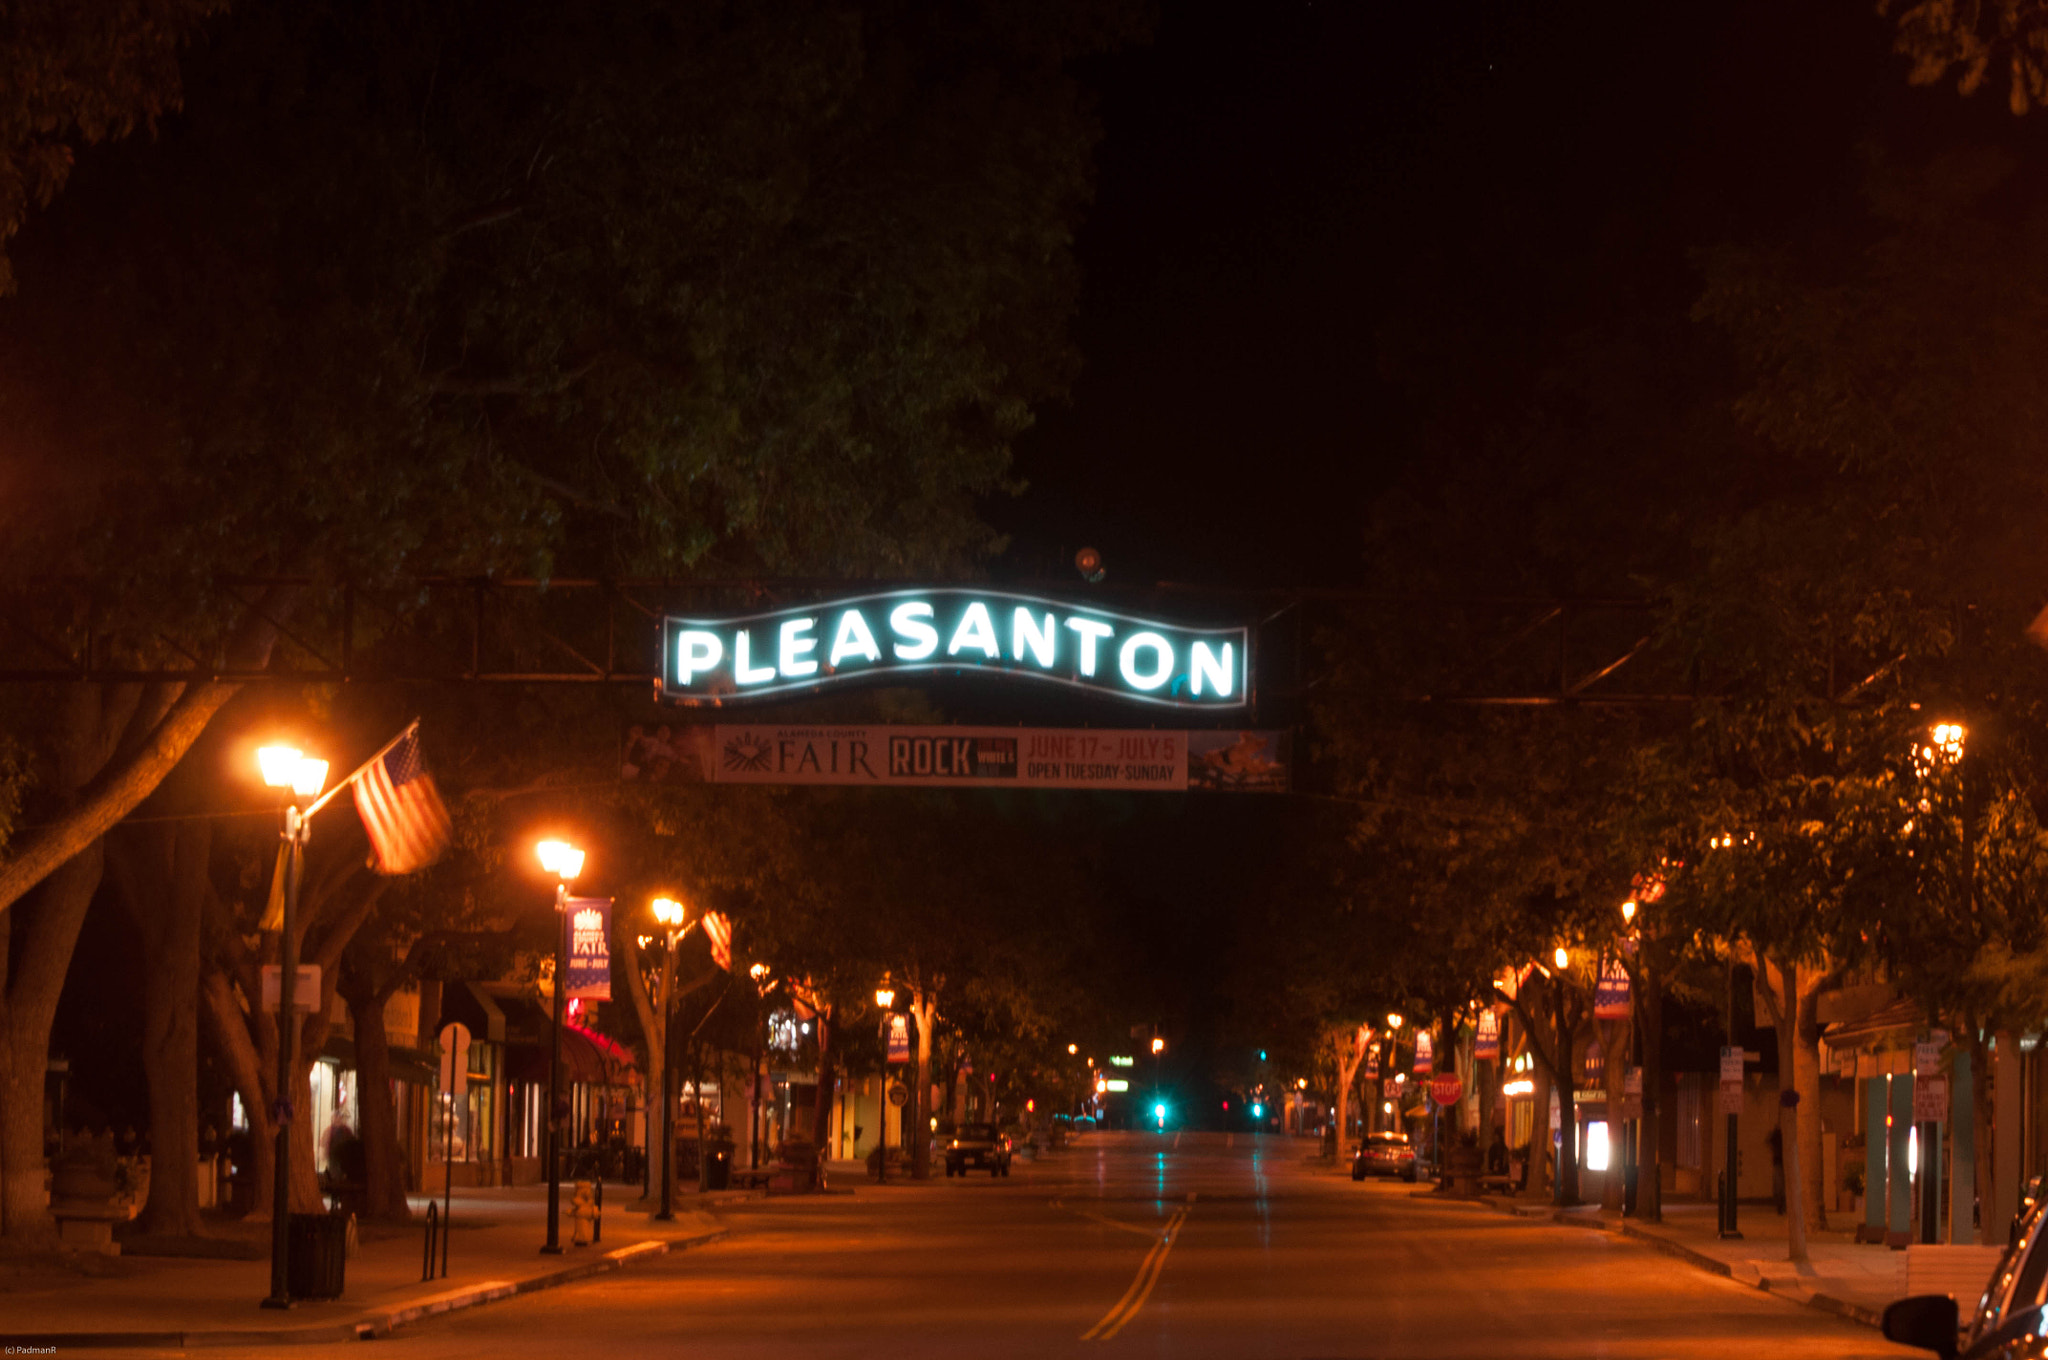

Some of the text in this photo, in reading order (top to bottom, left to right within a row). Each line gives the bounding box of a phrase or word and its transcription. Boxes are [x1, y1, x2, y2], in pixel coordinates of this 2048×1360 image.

[677, 601, 1233, 697] PLEASANTON
[777, 729, 867, 738] ALAMEDA COUNTY
[1028, 735, 1076, 758] JUNE
[1079, 736, 1099, 759] 17
[1117, 737, 1160, 761] JULY
[1163, 738, 1175, 761] 5
[777, 740, 878, 779] FAIR
[890, 736, 972, 776] ROCK
[977, 751, 1006, 764] WHITE
[1027, 761, 1061, 778] OPEN
[573, 942, 609, 955] FAIR
[569, 958, 588, 969] JUNE
[592, 958, 609, 969] JULY
[1433, 1083, 1459, 1093] STOP
